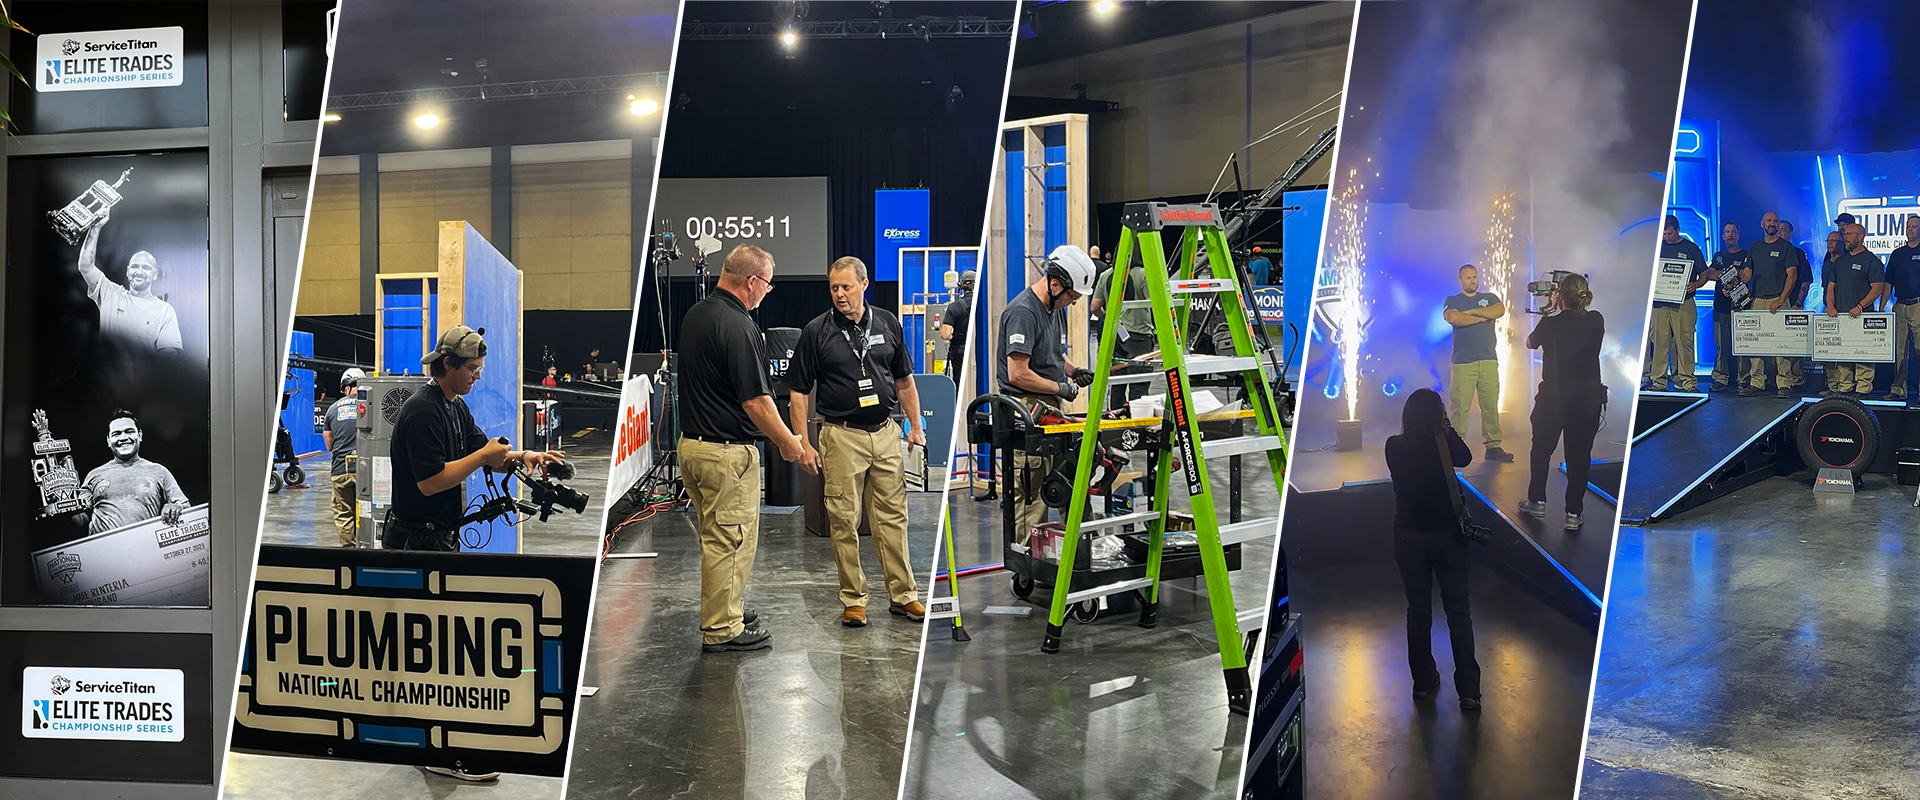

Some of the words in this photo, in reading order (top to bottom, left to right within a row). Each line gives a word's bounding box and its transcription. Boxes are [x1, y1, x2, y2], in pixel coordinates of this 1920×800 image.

[84, 39, 158, 52] ServiceTitan
[64, 57, 107, 75] ELITE
[110, 53, 173, 72] TRADES
[63, 74, 137, 85] CHAMPIONSHIP
[139, 72, 174, 81] SERIES
[1160, 208, 1187, 221] Little
[1187, 208, 1214, 221] Giant
[1854, 213, 1919, 236] LUM
[686, 215, 791, 239] 00:55:11
[1169, 371, 1180, 399] Little
[1174, 399, 1186, 427] Giant
[1181, 430, 1197, 482] A-FORCE300
[160, 531, 180, 540] ELITE
[181, 522, 207, 534] TRADES
[49, 555, 78, 568] NATIONAL
[164, 548, 184, 560] OCTOBER
[72, 591, 91, 603] JOSE
[90, 578, 130, 598] RENTERIA
[265, 604, 524, 679] PLUMBING
[75, 681, 155, 694] ServiceTitan
[278, 672, 365, 701] NATIONAL
[371, 680, 511, 711] CHAMPIONSHIP
[53, 700, 99, 719] ELITE
[104, 701, 173, 722] TRADES
[52, 722, 133, 732] CHAMPIONSHIP
[136, 724, 173, 733] SERIES
